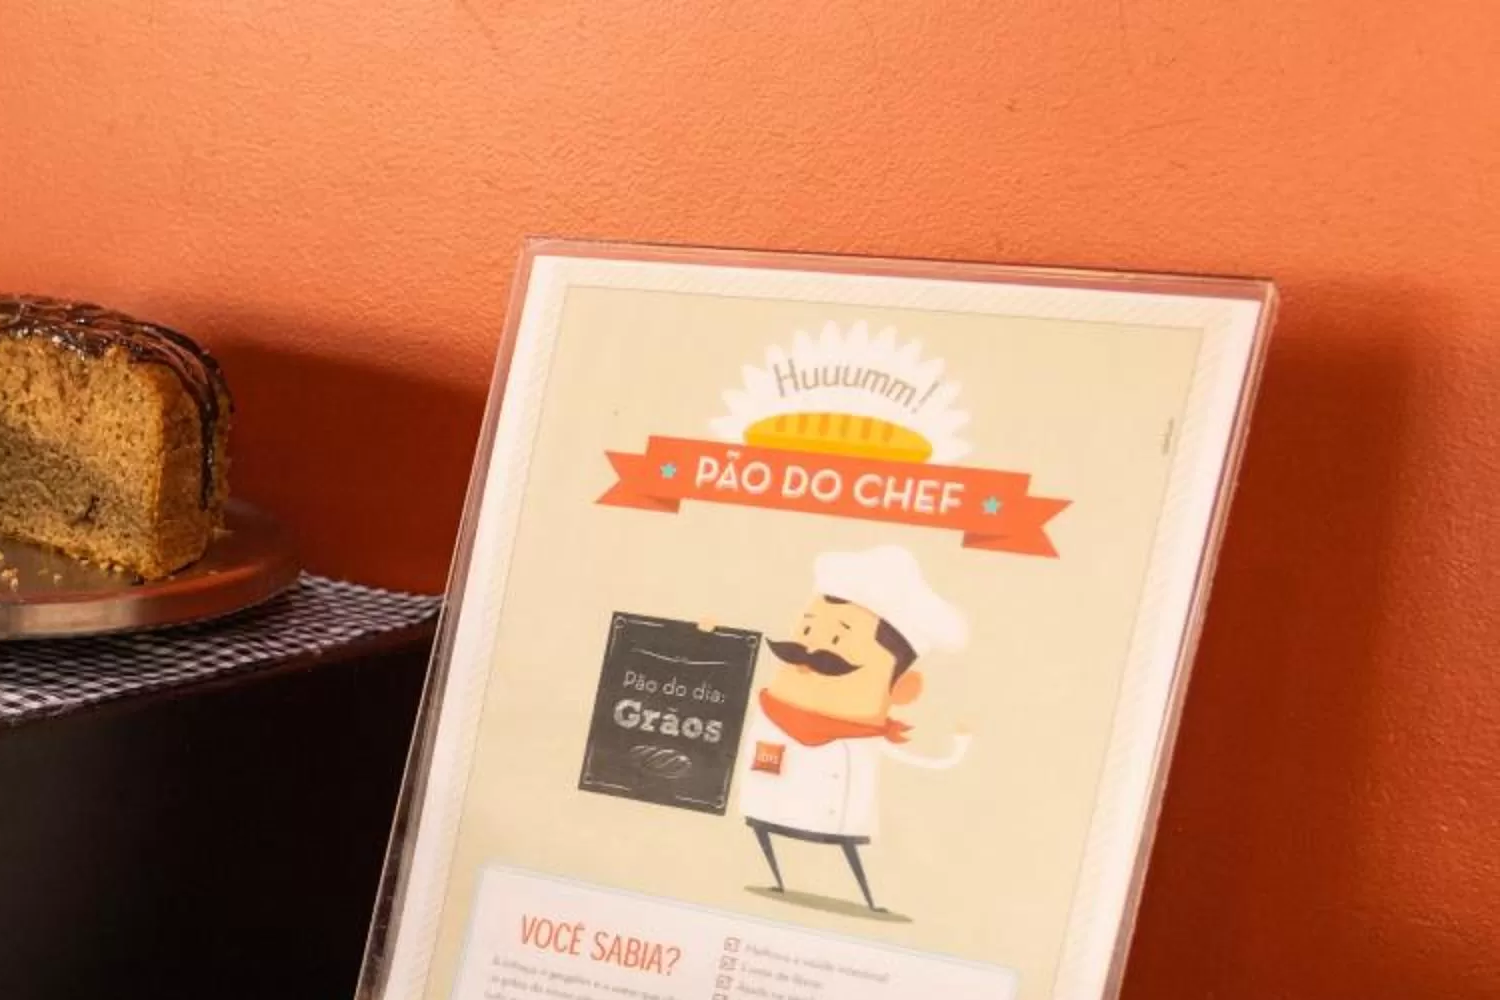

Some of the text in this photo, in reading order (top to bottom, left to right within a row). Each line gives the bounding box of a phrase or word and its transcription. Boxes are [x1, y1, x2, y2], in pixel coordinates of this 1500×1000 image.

[773, 358, 940, 414] Huuumm!
[695, 449, 965, 514] PÃO DO CHEF
[623, 670, 725, 704] Pão do dia:
[613, 699, 724, 743] Grãos
[590, 931, 682, 976] SABIA?
